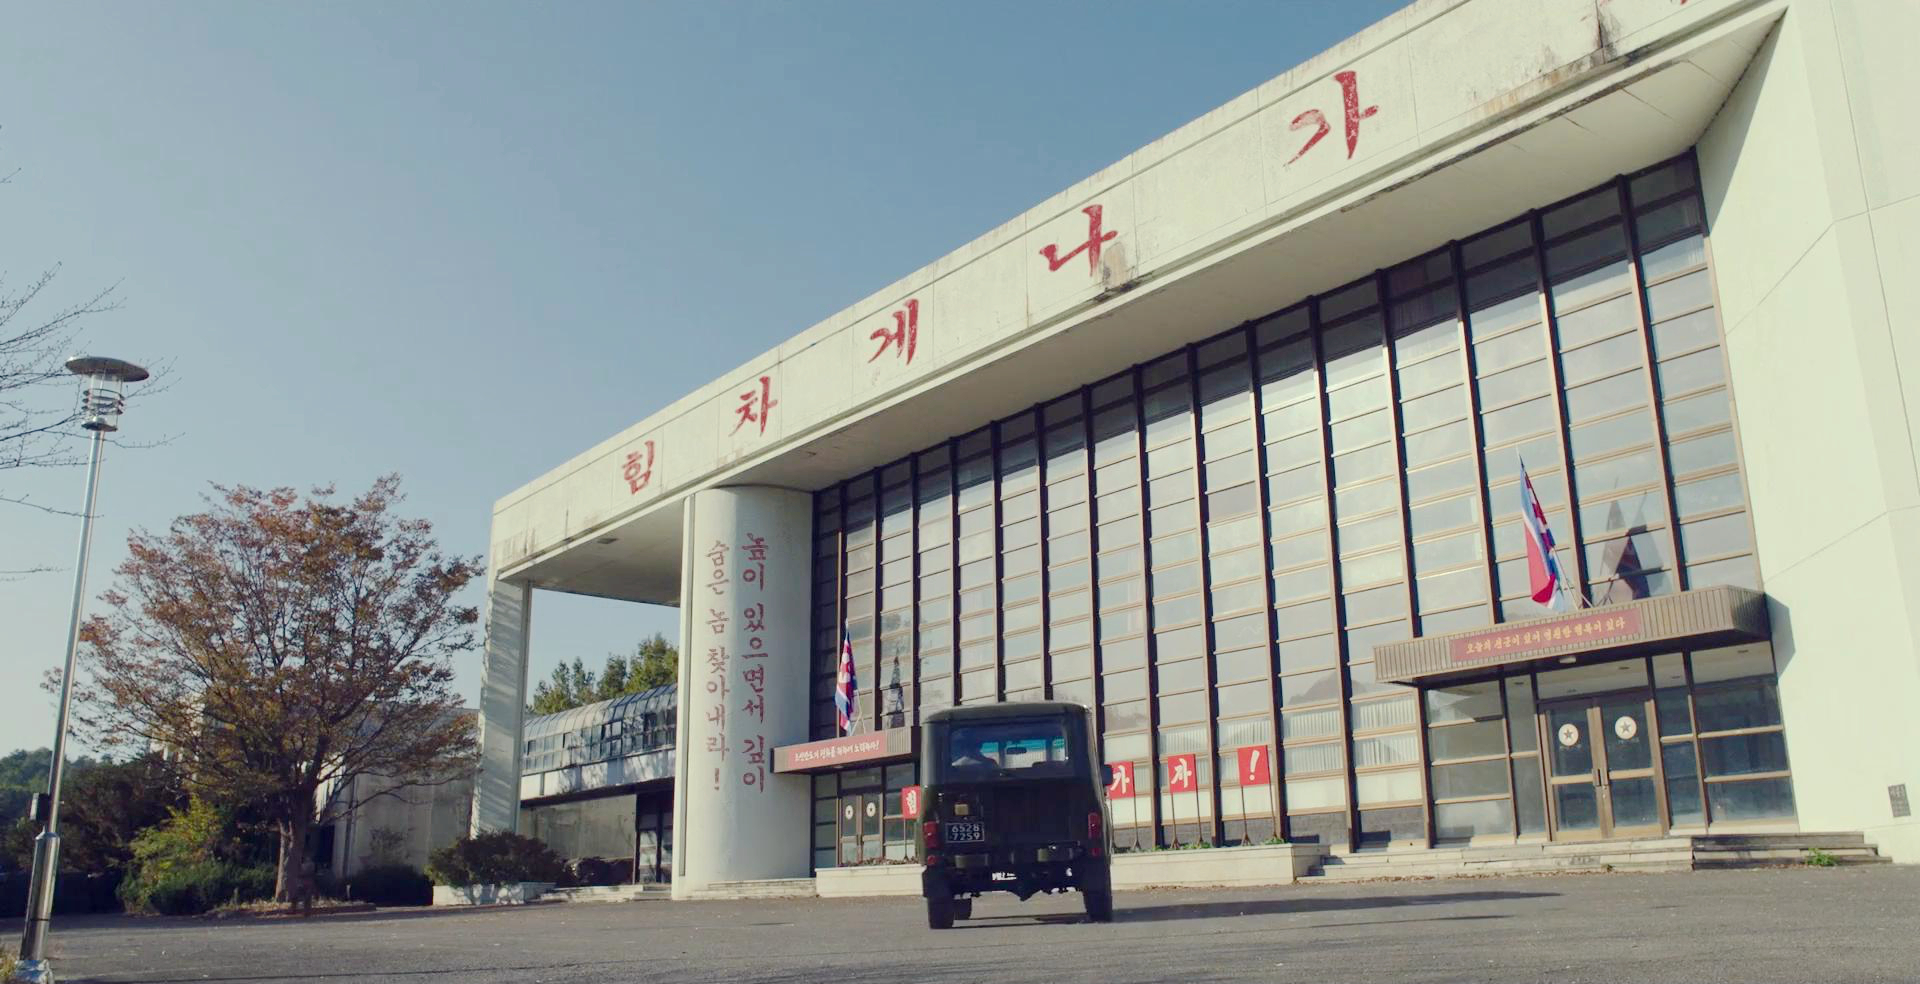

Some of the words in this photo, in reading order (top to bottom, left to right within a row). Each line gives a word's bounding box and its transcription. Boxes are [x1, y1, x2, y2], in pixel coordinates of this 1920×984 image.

[705, 540, 730, 595] 숨은
[741, 532, 769, 592] 높이
[705, 608, 730, 635] 놈
[1466, 639, 1491, 655] 오늘의
[1574, 620, 1602, 637] 행복이
[1606, 616, 1626, 632] 있다
[741, 602, 769, 724] 있으면서
[741, 734, 766, 793] 깊이
[1110, 764, 1131, 795] 가
[1170, 758, 1192, 788] 자
